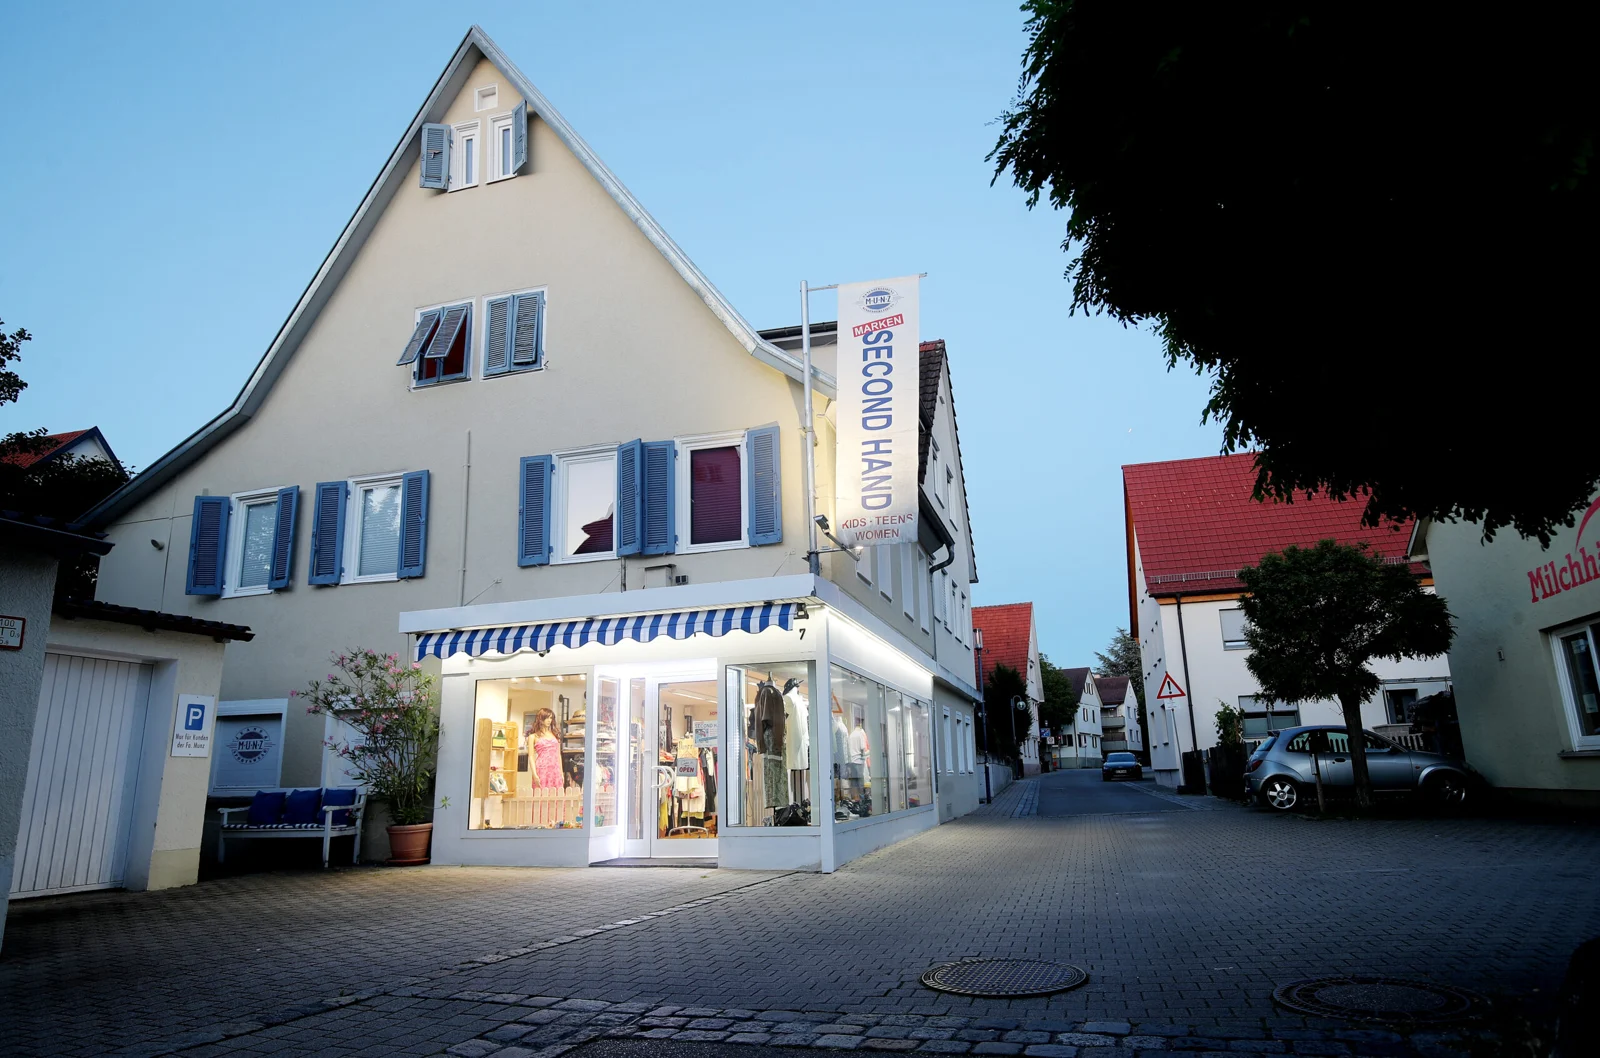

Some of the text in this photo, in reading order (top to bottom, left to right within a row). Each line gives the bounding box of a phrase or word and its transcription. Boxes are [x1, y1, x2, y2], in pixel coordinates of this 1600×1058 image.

[854, 316, 902, 336] MARKEN
[862, 330, 893, 430] SECOND
[862, 438, 892, 510] HAND
[842, 514, 913, 529] KIDS TEENS
[855, 529, 899, 540] WOMEN
[1527, 541, 1600, 603] Milchh
[799, 628, 806, 640] 7
[188, 708, 202, 726] P
